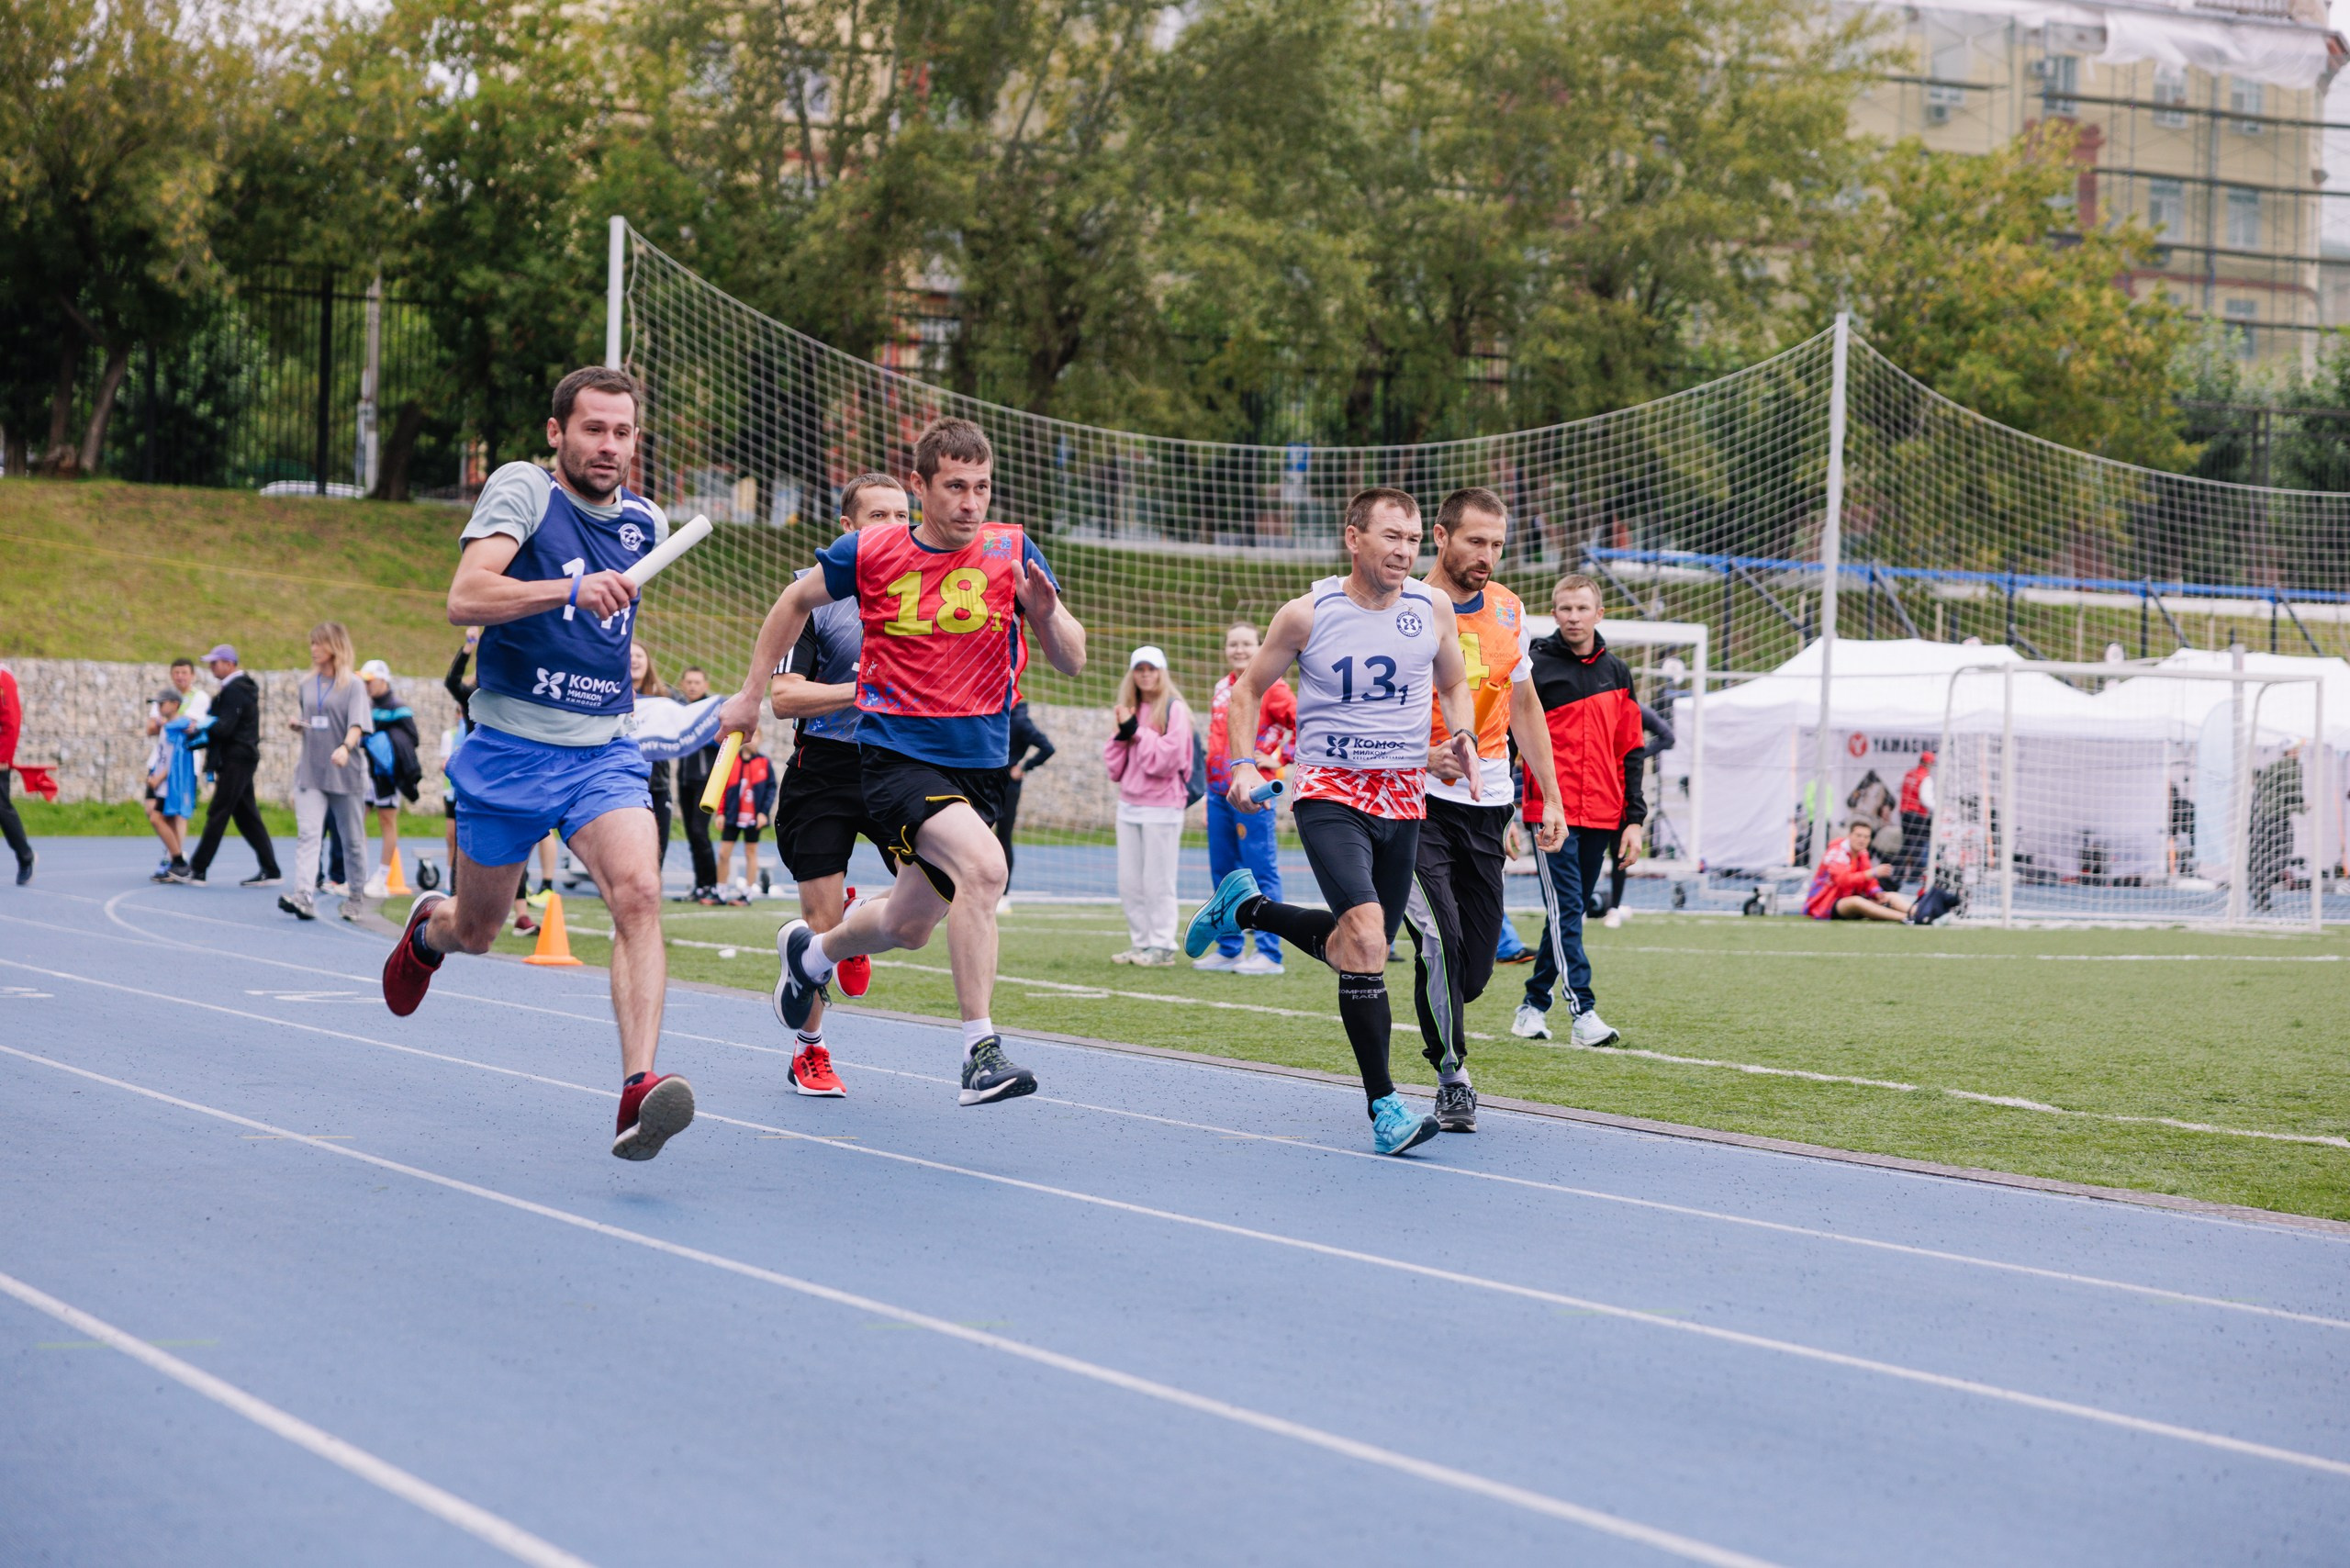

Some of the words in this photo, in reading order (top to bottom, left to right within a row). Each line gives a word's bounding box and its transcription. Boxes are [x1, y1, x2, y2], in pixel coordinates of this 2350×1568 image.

[884, 567, 989, 636] 18
[990, 610, 1004, 633] 1
[568, 674, 621, 694] КОМОС
[1331, 655, 1396, 703] 13
[1397, 684, 1409, 706] 1
[566, 689, 603, 702] МИЛКОМ
[1354, 738, 1406, 749] КОМОС
